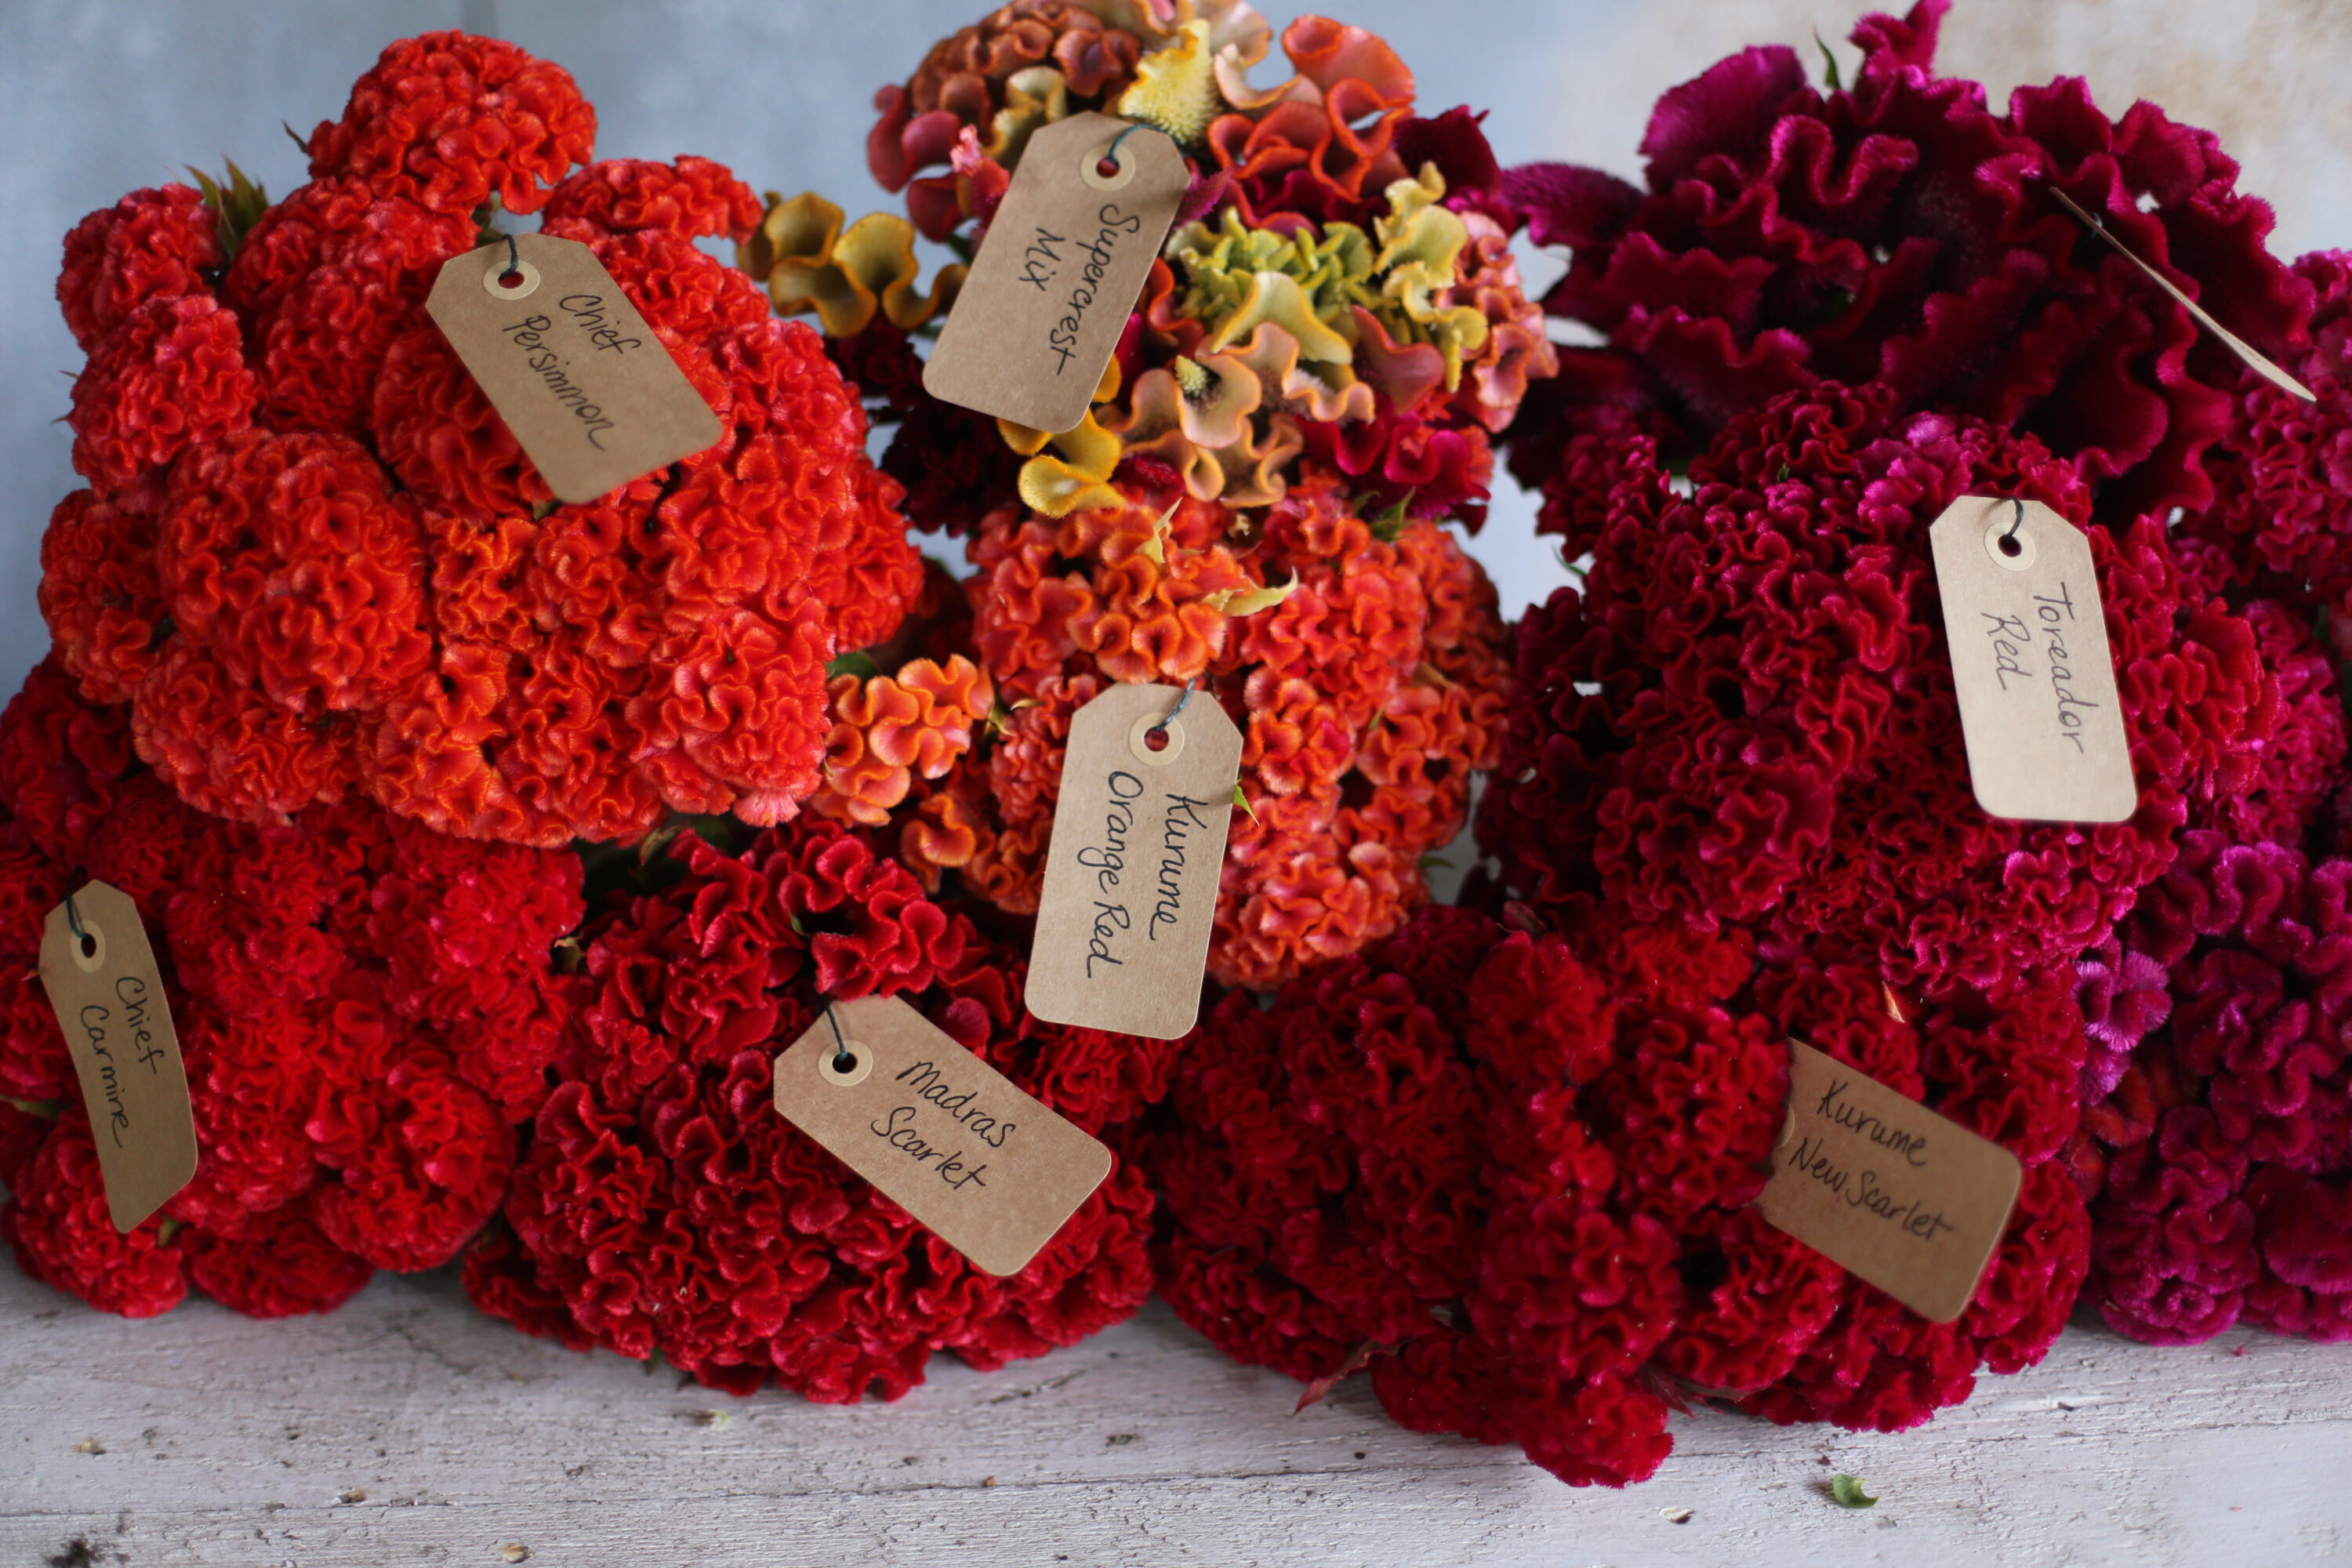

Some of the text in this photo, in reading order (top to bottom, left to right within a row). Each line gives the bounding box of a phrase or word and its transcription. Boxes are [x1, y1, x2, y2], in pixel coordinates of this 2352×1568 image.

[1018, 227, 1065, 292] Mix
[1050, 204, 1140, 376] Supercrest
[559, 295, 641, 354] Chief
[502, 315, 615, 451] Persimmon
[1980, 612, 2032, 691] Red
[2034, 582, 2099, 753] Toreador
[1078, 771, 1144, 978] Orange Red
[1149, 793, 1208, 941] Kurume
[116, 976, 165, 1074] Chief
[81, 1004, 129, 1149] Carmine
[895, 1061, 1016, 1148] Madras
[1816, 1080, 1926, 1167] Kurume
[870, 1106, 987, 1189] Scarlet
[1788, 1136, 1953, 1240] New Scarlet
